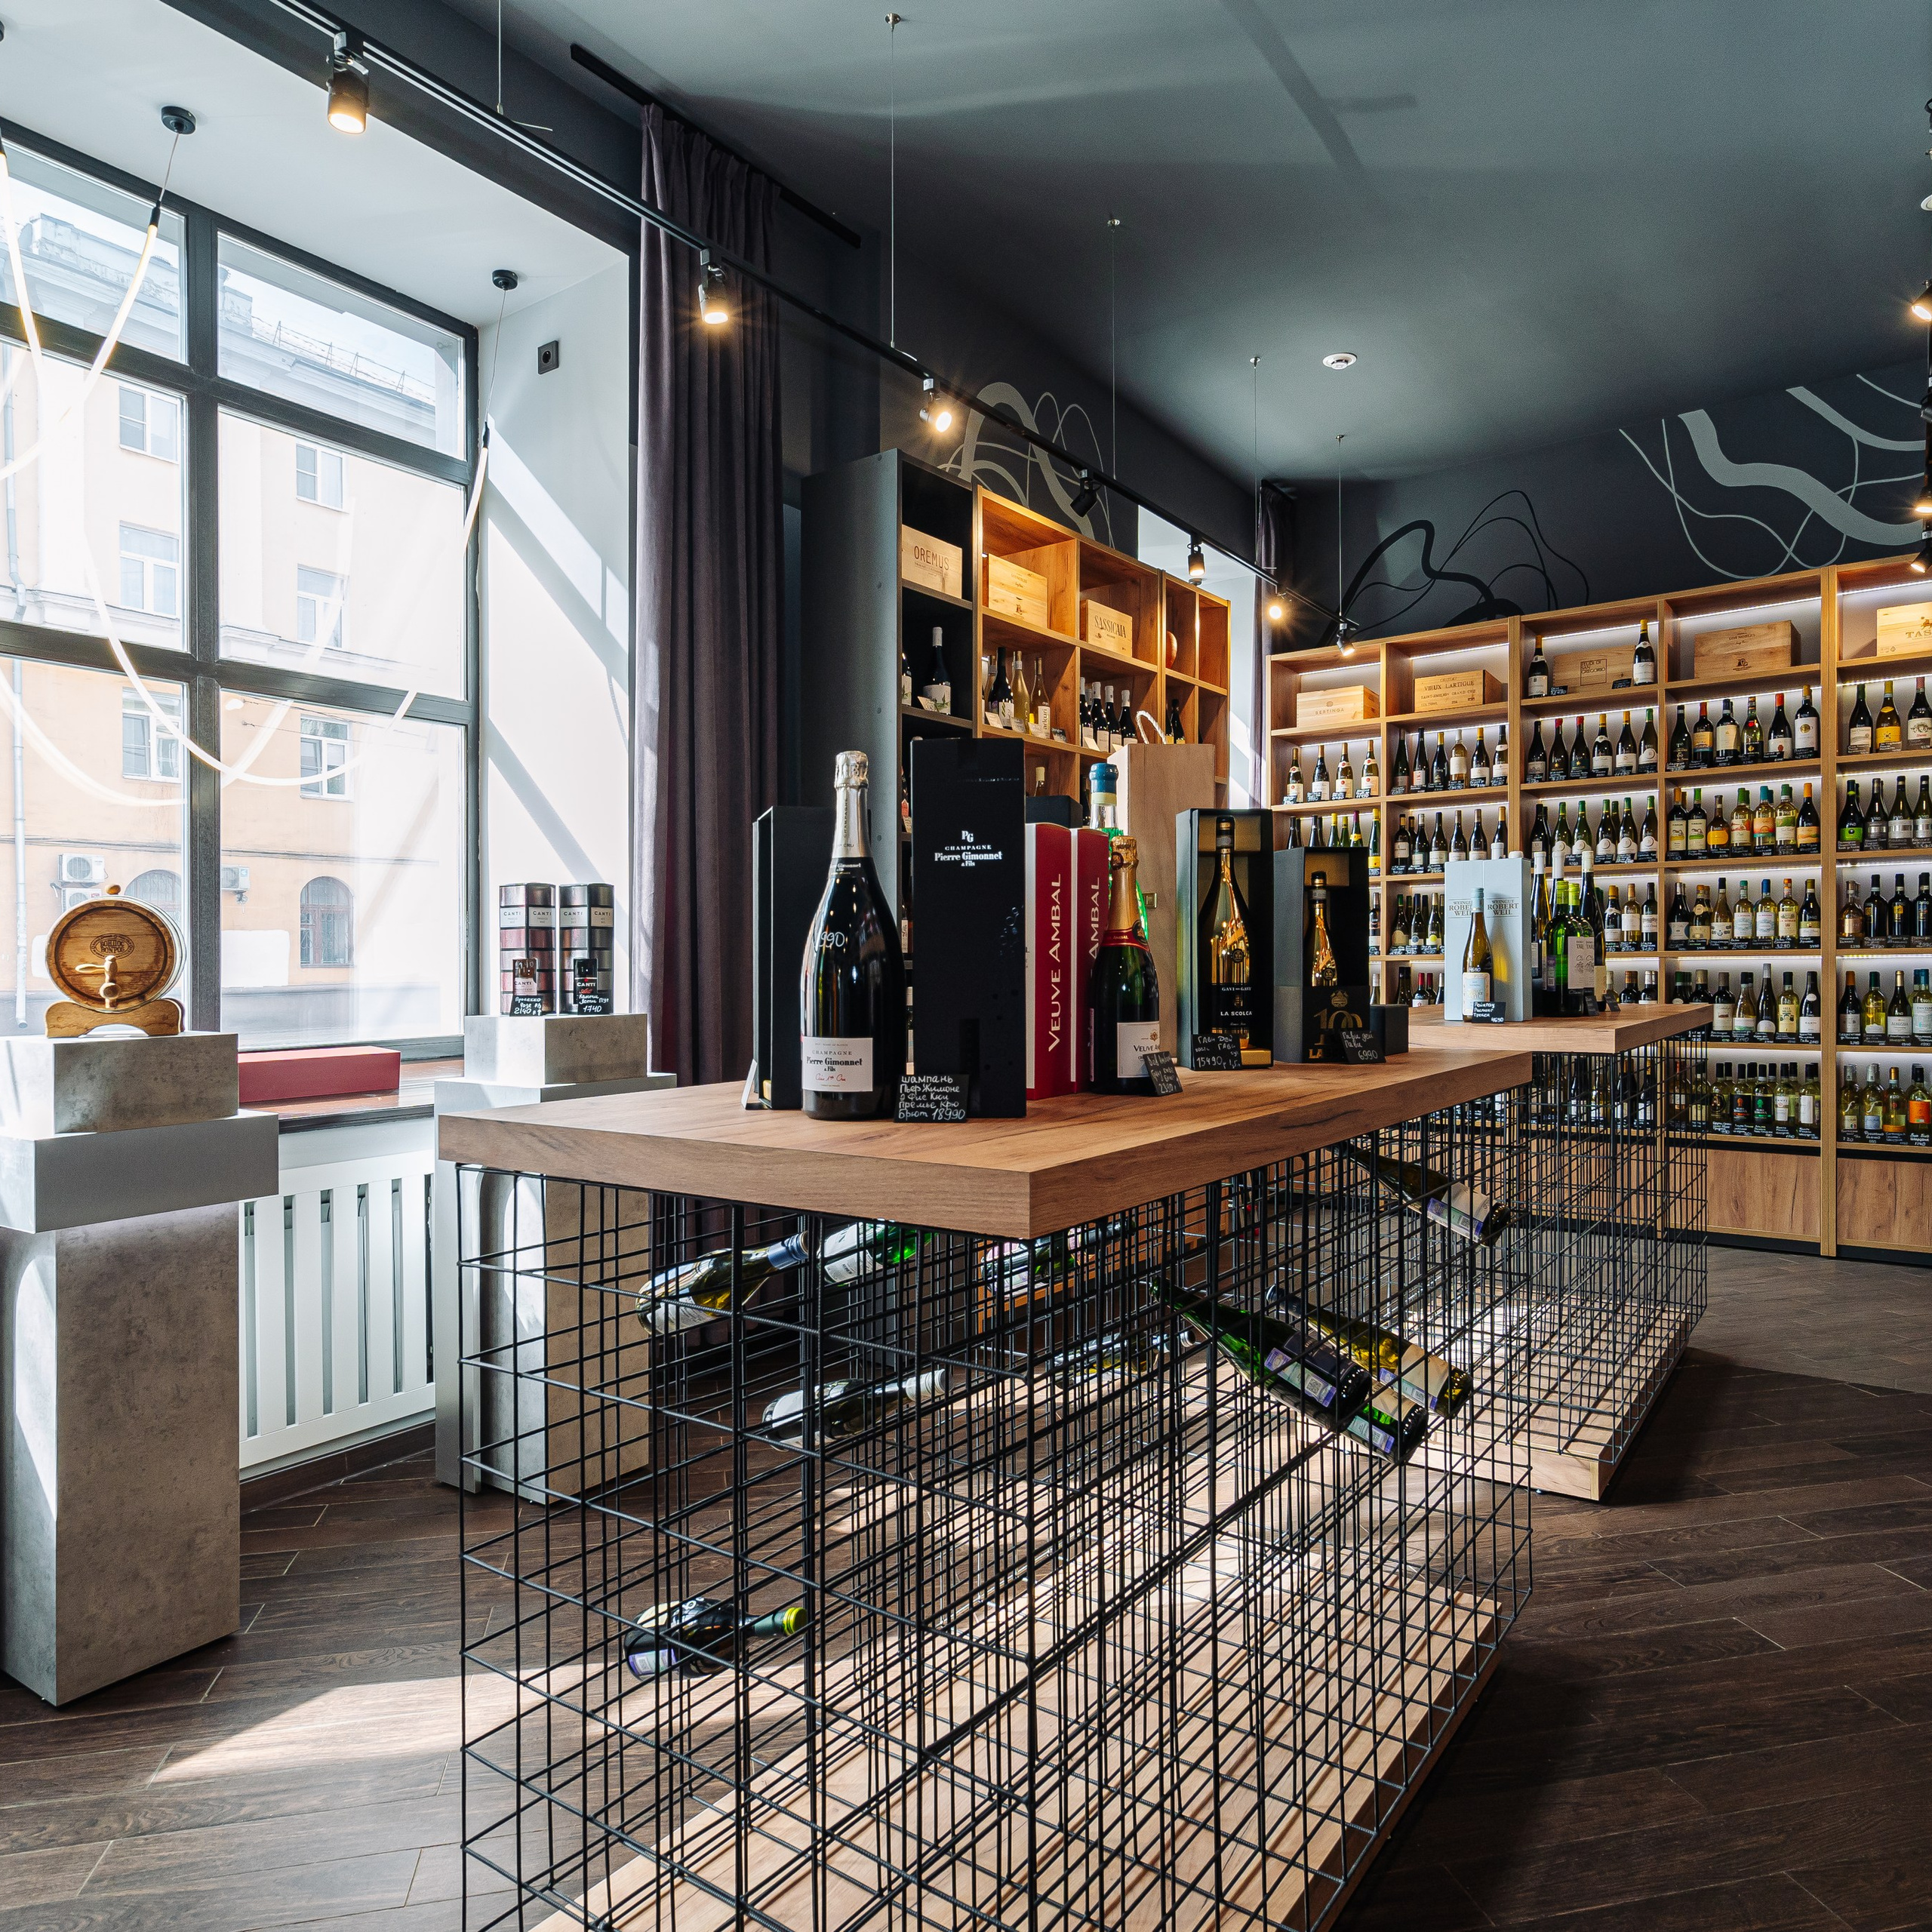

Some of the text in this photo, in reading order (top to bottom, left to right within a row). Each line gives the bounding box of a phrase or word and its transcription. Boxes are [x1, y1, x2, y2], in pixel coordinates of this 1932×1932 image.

[914, 546, 949, 571] OREMUS
[1094, 615, 1126, 638] SASSICAIA
[1445, 681, 1475, 689] LARTIGUE
[961, 830, 974, 843] PG
[934, 851, 1002, 861] Pierre Gimonnet
[1088, 877, 1100, 960] AMBAL
[1048, 874, 1061, 1052] VEUVE AMBAL
[1358, 1050, 1378, 1060] 6990
[806, 1057, 863, 1066] Pierre Gimonnet
[1196, 1056, 1223, 1068] 15490
[900, 1083, 960, 1095] Пьер Жимоне
[930, 1092, 949, 1100] Кюи
[898, 1108, 966, 1121] Брют 18990
